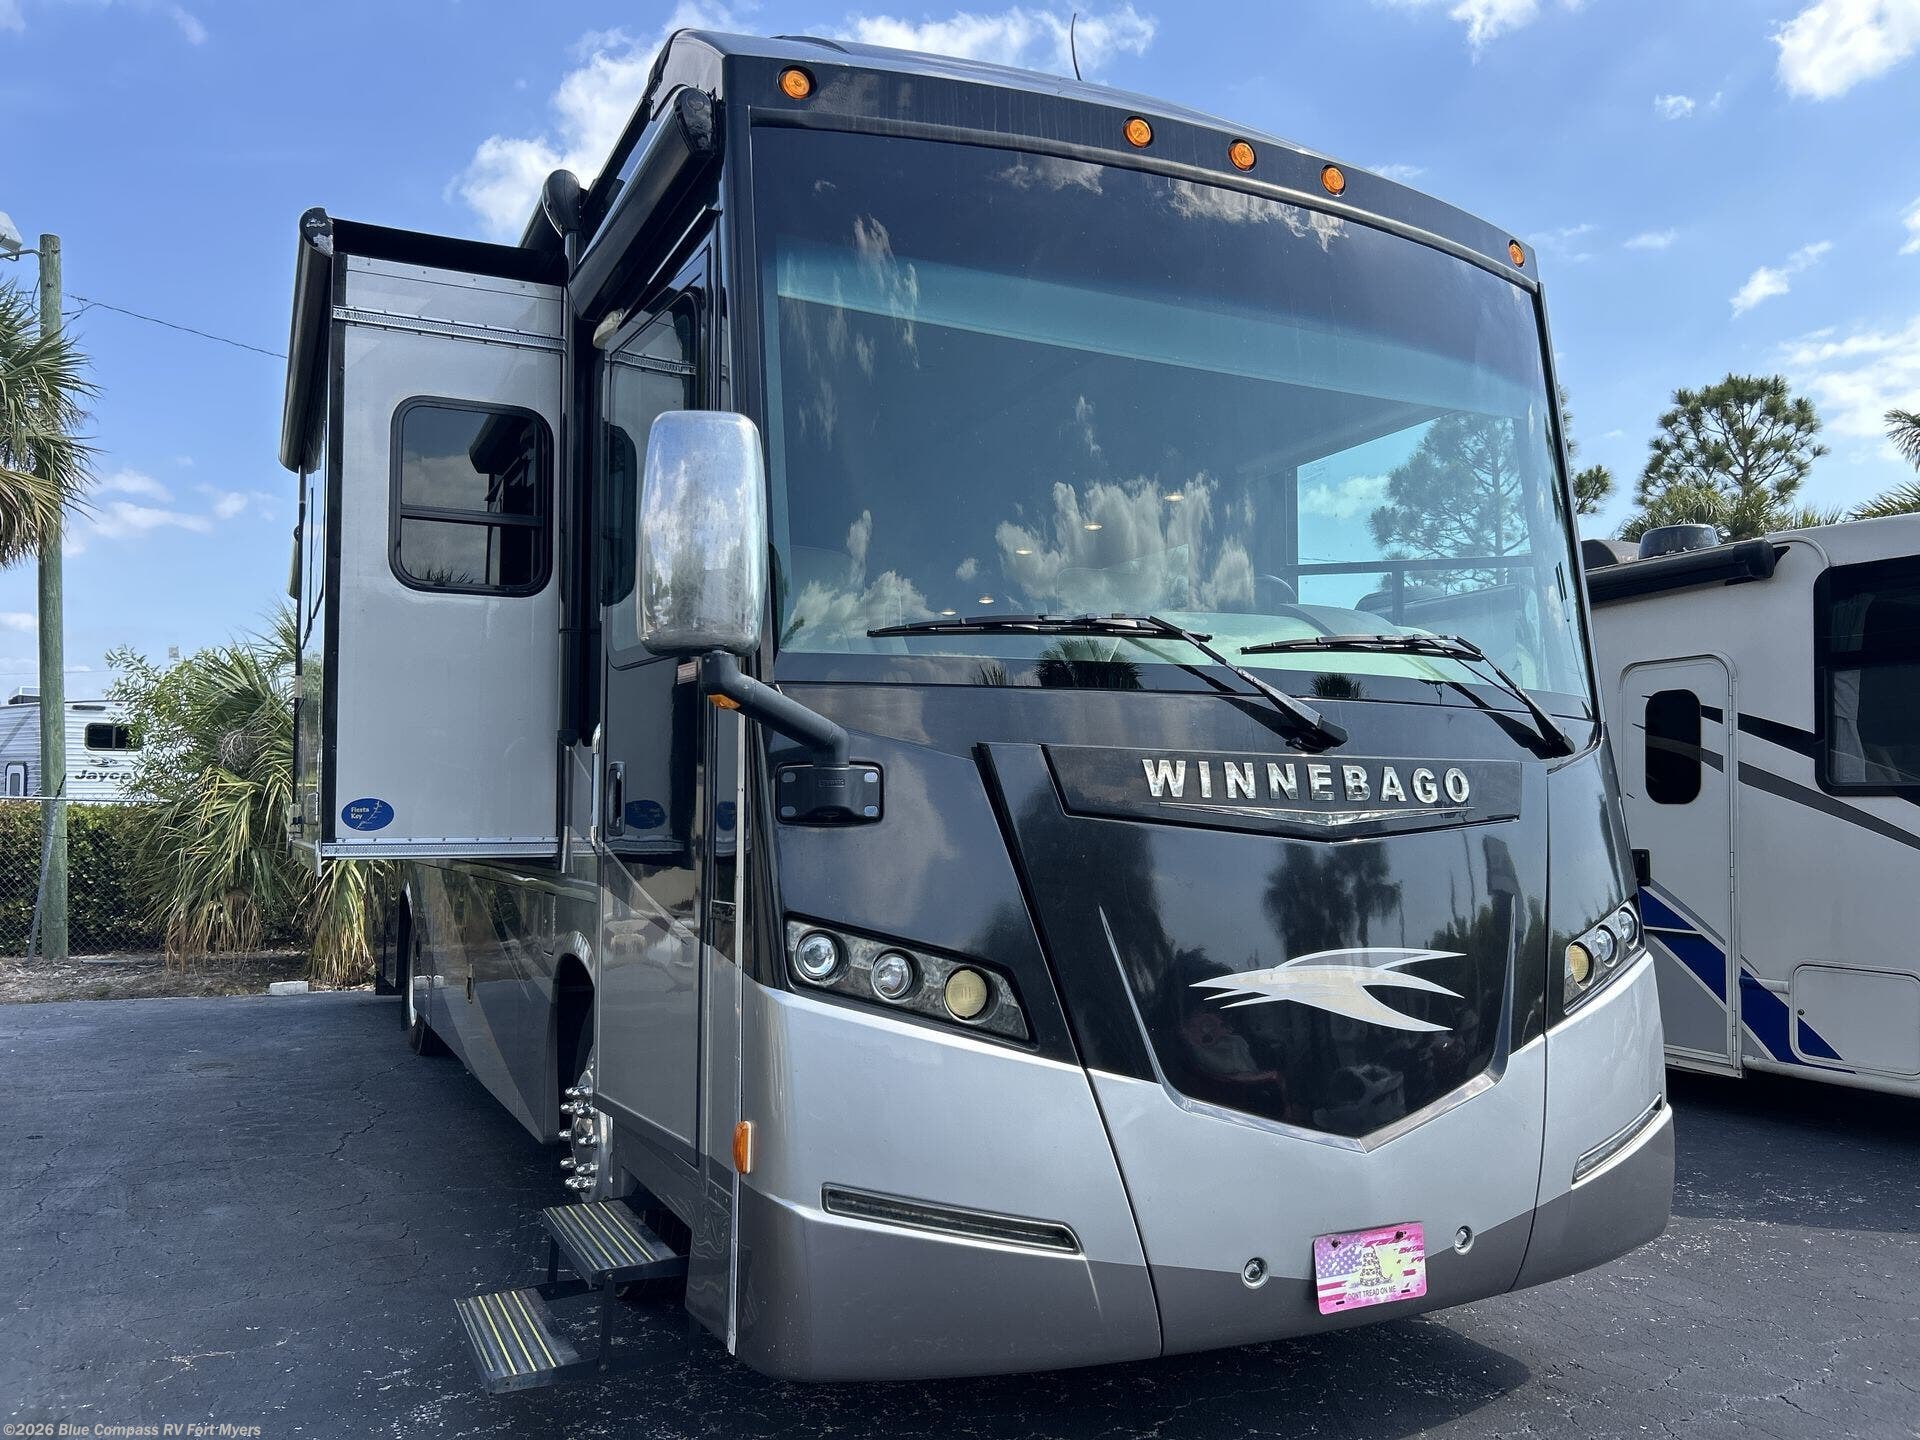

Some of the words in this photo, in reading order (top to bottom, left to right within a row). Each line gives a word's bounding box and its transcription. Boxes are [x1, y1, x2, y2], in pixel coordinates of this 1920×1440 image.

[1142, 759, 1471, 803] WINNEBAGO
[1363, 1288, 1379, 1297] TREAD
[1380, 1286, 1389, 1294] ON
